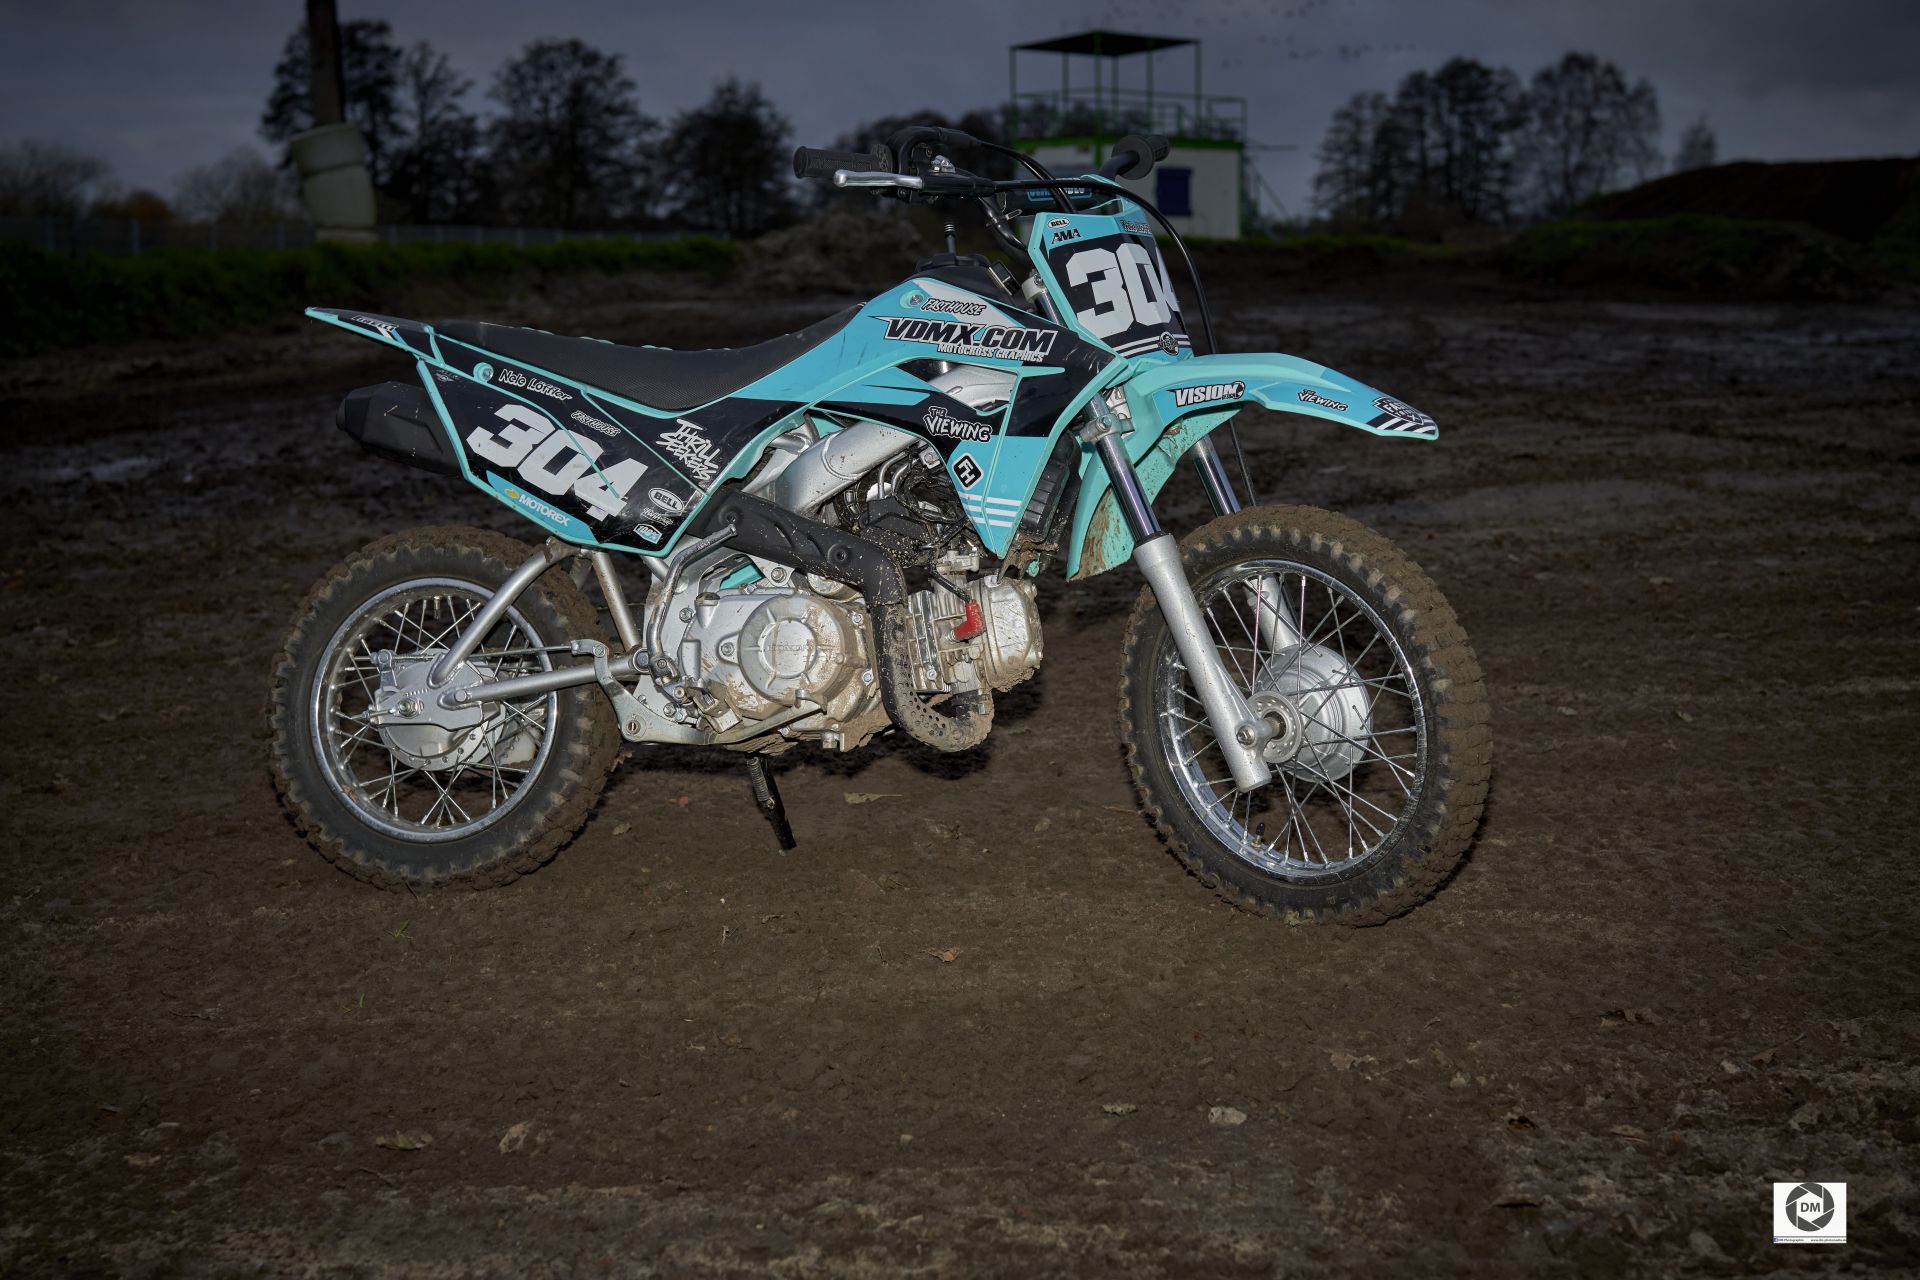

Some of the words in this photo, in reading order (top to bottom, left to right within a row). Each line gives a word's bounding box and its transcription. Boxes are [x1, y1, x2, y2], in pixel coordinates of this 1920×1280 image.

[1050, 219, 1068, 227] BELL
[1051, 228, 1081, 244] AMA
[921, 298, 987, 316] FASTHOUSE
[884, 317, 1058, 355] VDMX.COM
[937, 343, 994, 358] MOTOCROSS
[995, 348, 1045, 363] GRAPHICS
[1174, 383, 1240, 407] VISION
[1298, 392, 1348, 411] VIEWING
[570, 410, 621, 437] FASTHOUSE
[925, 416, 991, 442] VIEWING
[674, 418, 721, 469] THRILL
[466, 404, 649, 522] 304
[655, 432, 717, 481] SEEKERS
[519, 494, 571, 526] MOTOREX
[653, 491, 679, 509] BELL
